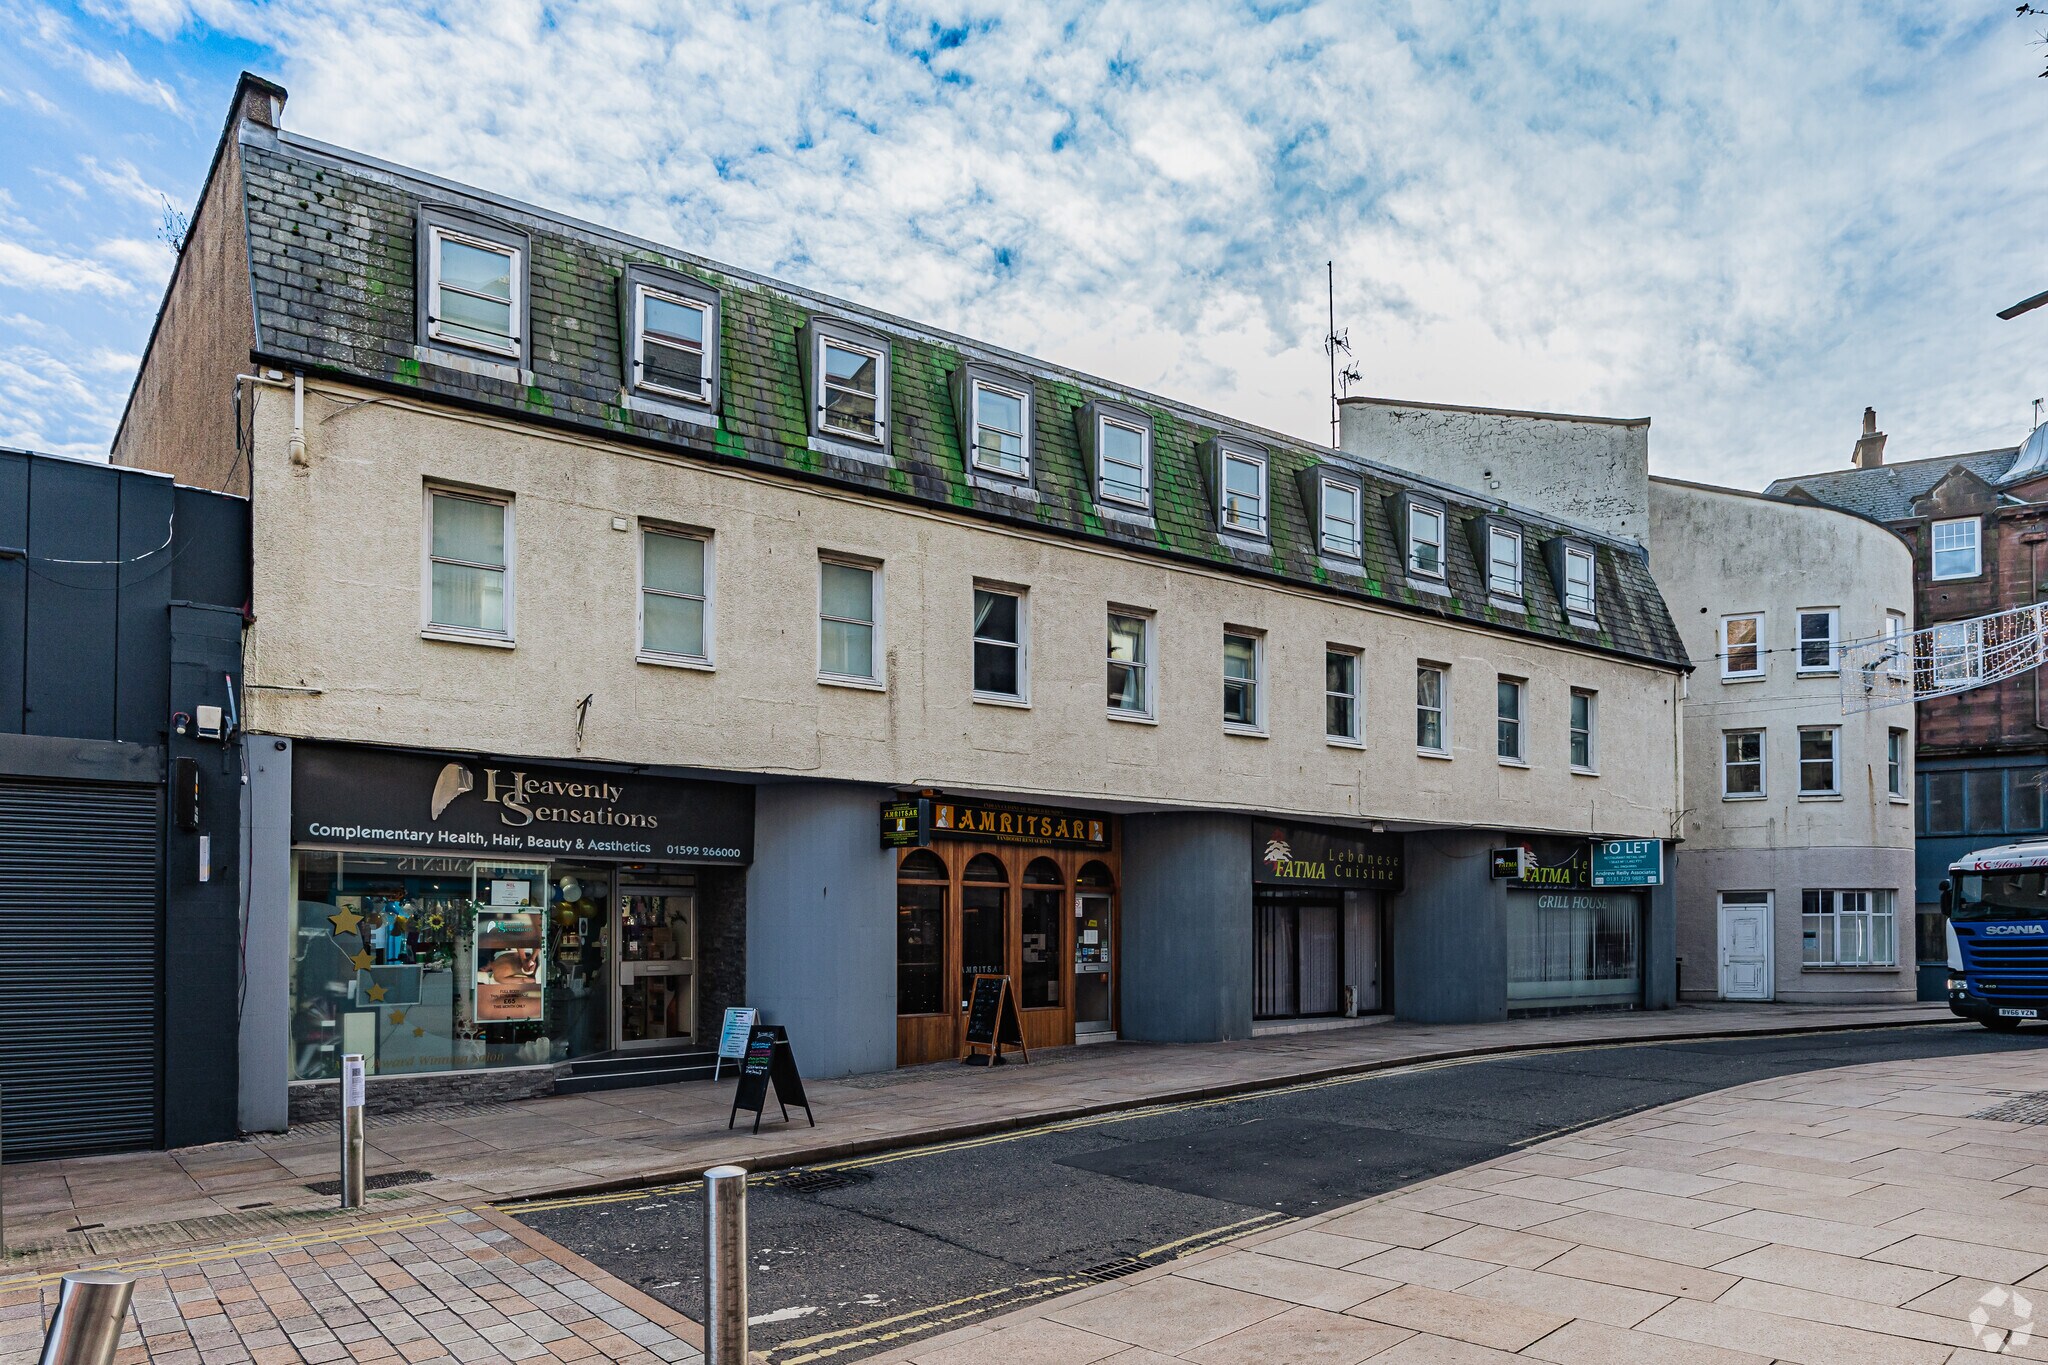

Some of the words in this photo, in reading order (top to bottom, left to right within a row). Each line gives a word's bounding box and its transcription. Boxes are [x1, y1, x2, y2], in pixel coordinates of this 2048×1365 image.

[483, 769, 623, 804] Heavenly
[501, 791, 658, 828] Sensations
[884, 809, 918, 818] AMRITSAR
[958, 809, 1085, 839] AMRITSAR
[309, 822, 434, 844] Complementary
[438, 830, 488, 846] Health,
[493, 834, 523, 848] Hair,
[527, 835, 573, 851] Beauty
[575, 838, 585, 850] &
[587, 839, 651, 853] Aesthetics
[666, 845, 700, 856] 01592
[702, 848, 741, 858] 266000
[1022, 836, 1052, 845] RESTAURANT
[1601, 843, 1620, 854] TO
[1626, 842, 1650, 853] LET
[1275, 859, 1326, 880] FATMA
[1329, 848, 1399, 866] Lebanese
[1974, 861, 1991, 871] KC
[1334, 864, 1393, 880] Cuisine
[1522, 867, 1570, 884] FATMA
[1538, 895, 1569, 909] GRILL
[1572, 896, 1608, 909] HOUSE
[1986, 925, 2045, 935] SCANIA
[962, 965, 1003, 974] MRITSA
